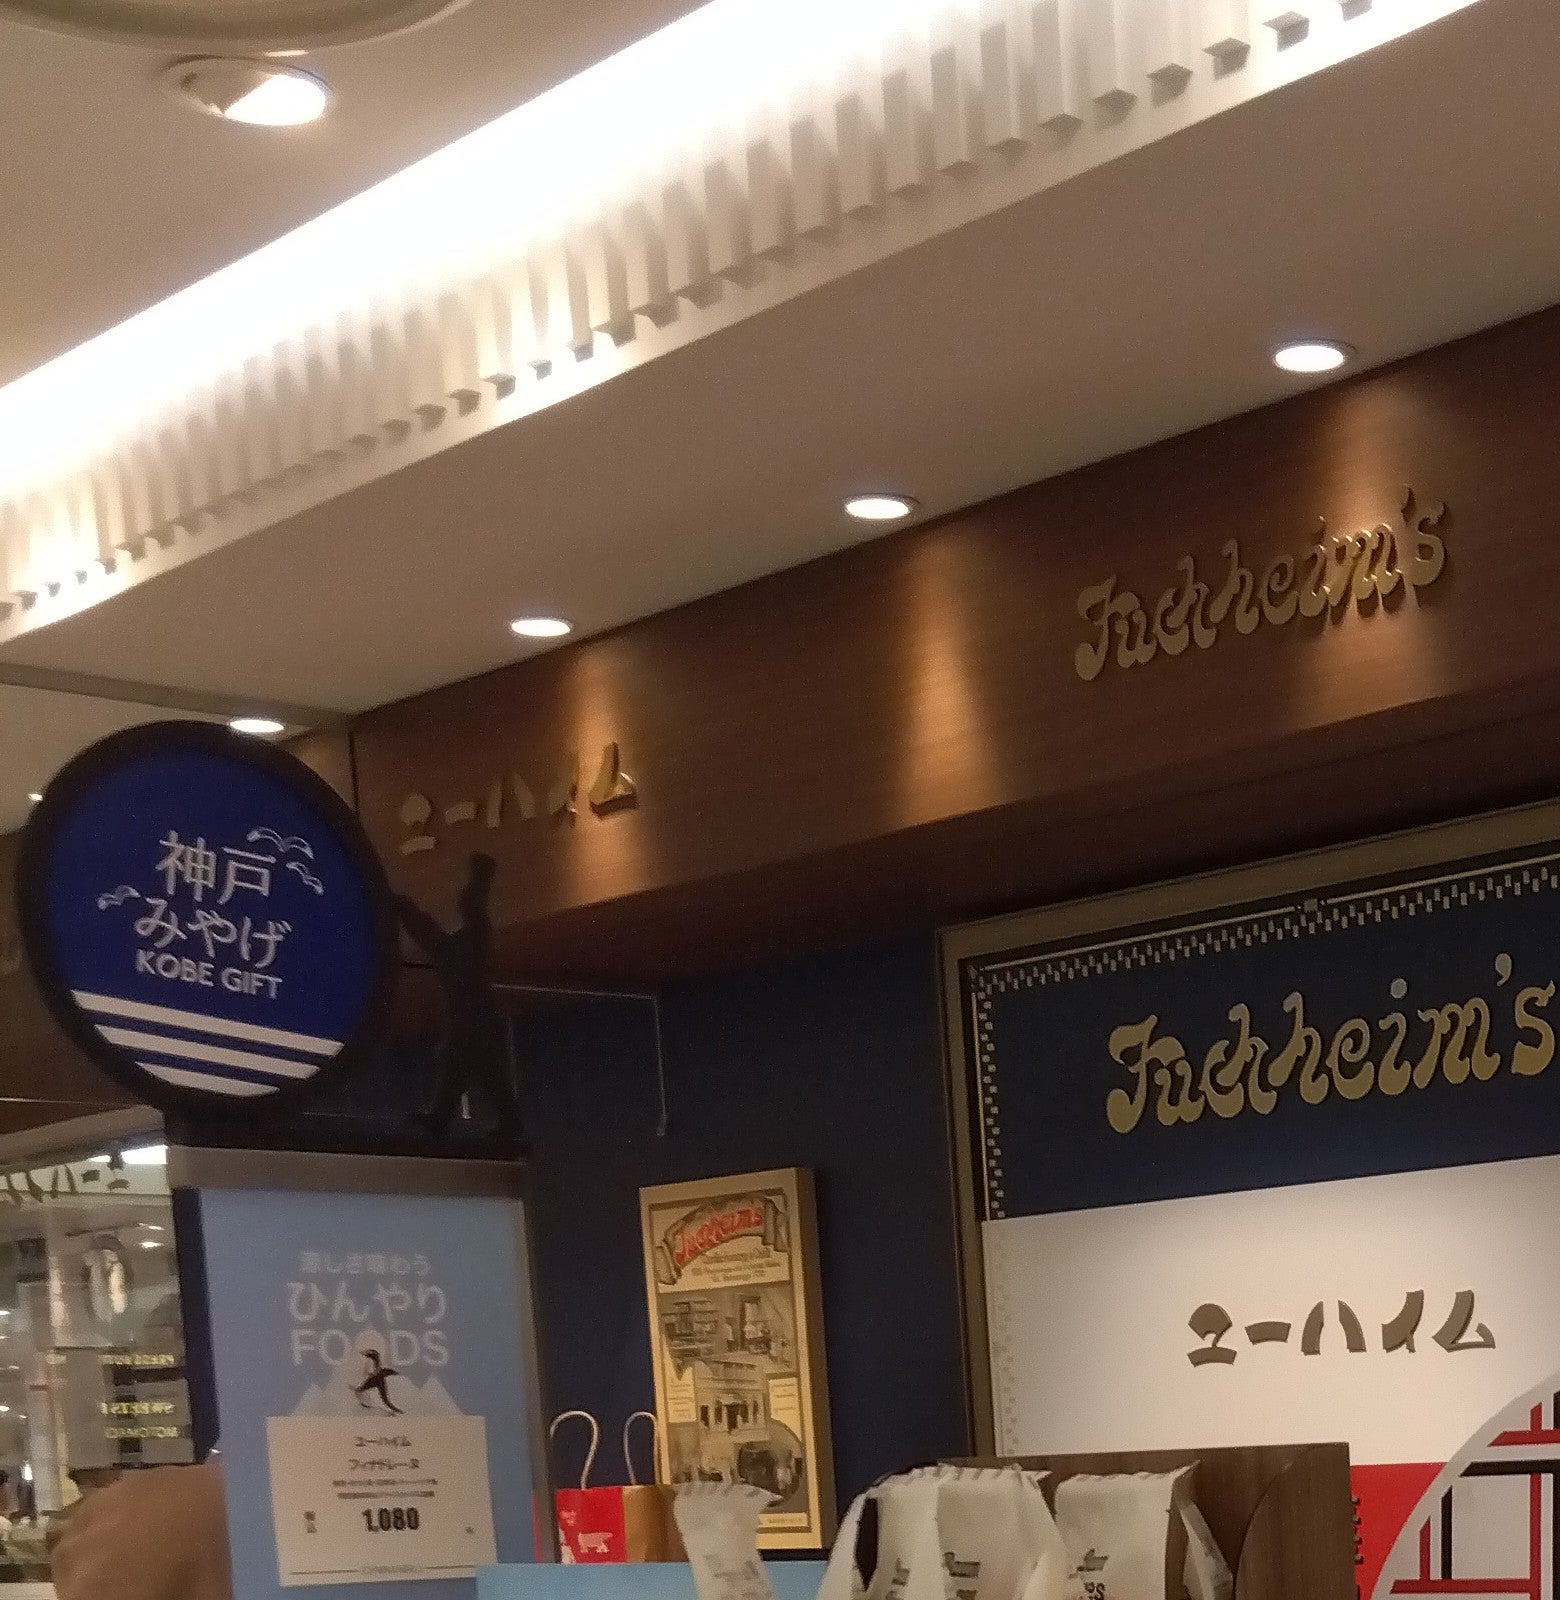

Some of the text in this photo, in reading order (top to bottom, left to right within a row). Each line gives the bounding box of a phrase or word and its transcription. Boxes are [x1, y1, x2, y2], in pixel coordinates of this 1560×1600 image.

[1073, 484, 1448, 681] Juchheim's
[156, 830, 276, 904] 神戸
[134, 897, 292, 970] みやげ
[135, 948, 284, 1000] KOBE GIFT
[1105, 952, 1558, 1134] Juchheim's
[286, 1280, 447, 1325] ひんやり
[1187, 1287, 1497, 1368] ユーハイム
